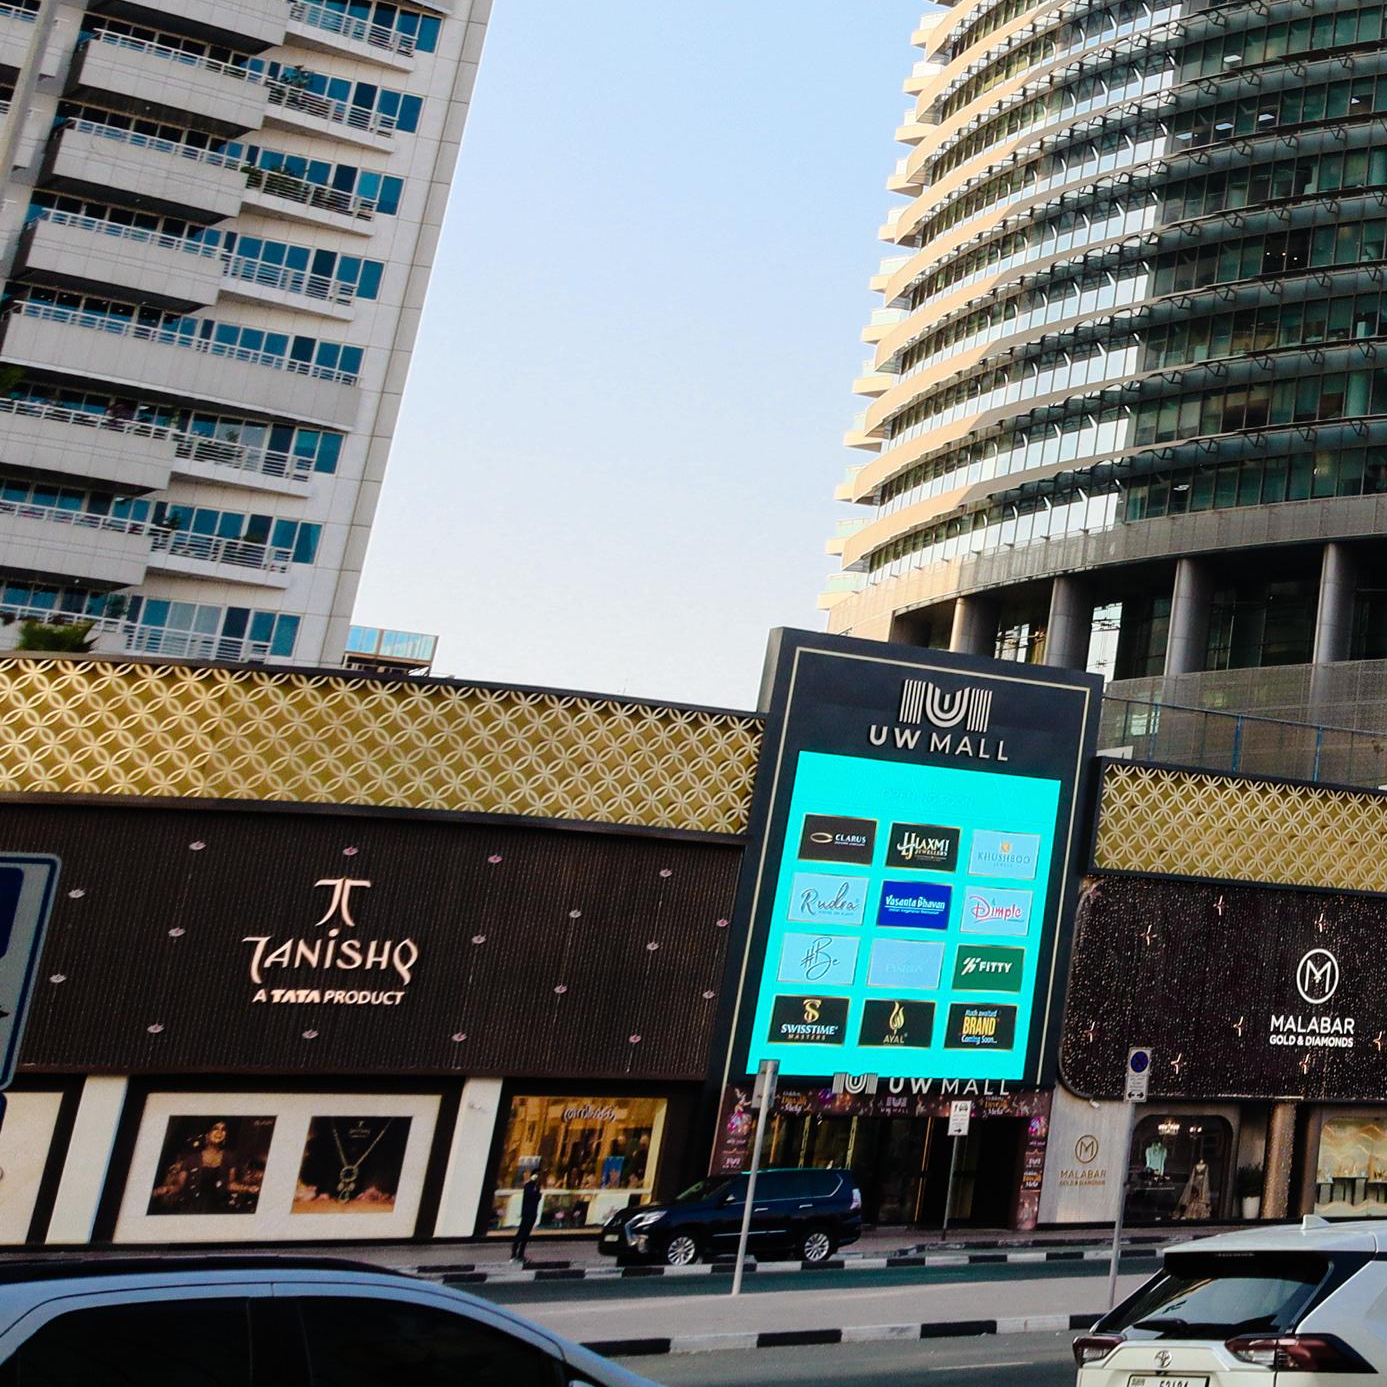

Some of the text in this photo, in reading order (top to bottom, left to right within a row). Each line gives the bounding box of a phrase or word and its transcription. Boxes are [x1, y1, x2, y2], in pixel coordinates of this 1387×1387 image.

[869, 724, 1009, 761] UW MALL
[835, 833, 867, 844] CLARUS
[914, 836, 950, 852] LAXMI
[977, 851, 1031, 864] KHUSHBOO
[885, 895, 917, 908] Vasanta
[969, 895, 1022, 922] Dimple
[978, 961, 1013, 973] FITTY
[252, 988, 406, 1005] A TATA PRODUCT
[780, 1023, 836, 1035] SWISSTIME
[962, 1016, 996, 1036] BRAND
[1269, 1014, 1355, 1035] MALABAR
[883, 1034, 905, 1044] AYAL
[1269, 1034, 1354, 1048] GOLD & DIAMONDS
[889, 1077, 1011, 1095] UW MALL
[1060, 1168, 1107, 1180] MALABAR
